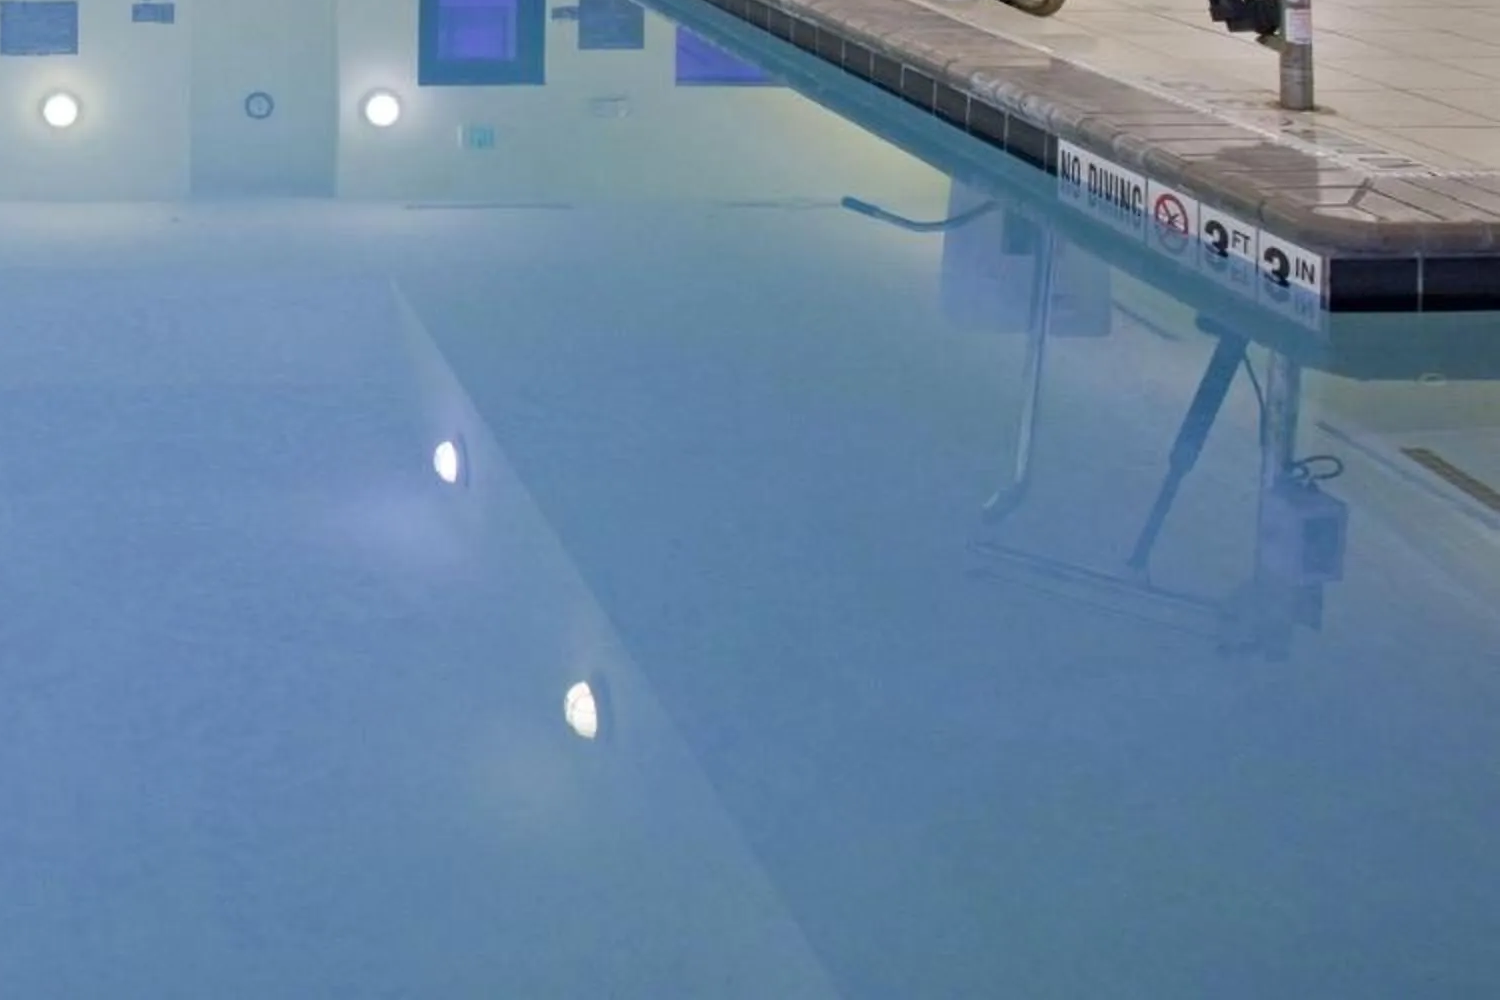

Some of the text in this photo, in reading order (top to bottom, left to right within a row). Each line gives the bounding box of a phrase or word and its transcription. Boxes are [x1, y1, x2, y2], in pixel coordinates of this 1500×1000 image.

[1061, 149, 1081, 187] NO
[1087, 163, 1142, 217] DIVING
[1231, 230, 1251, 254] FT
[1295, 259, 1315, 285] IN
